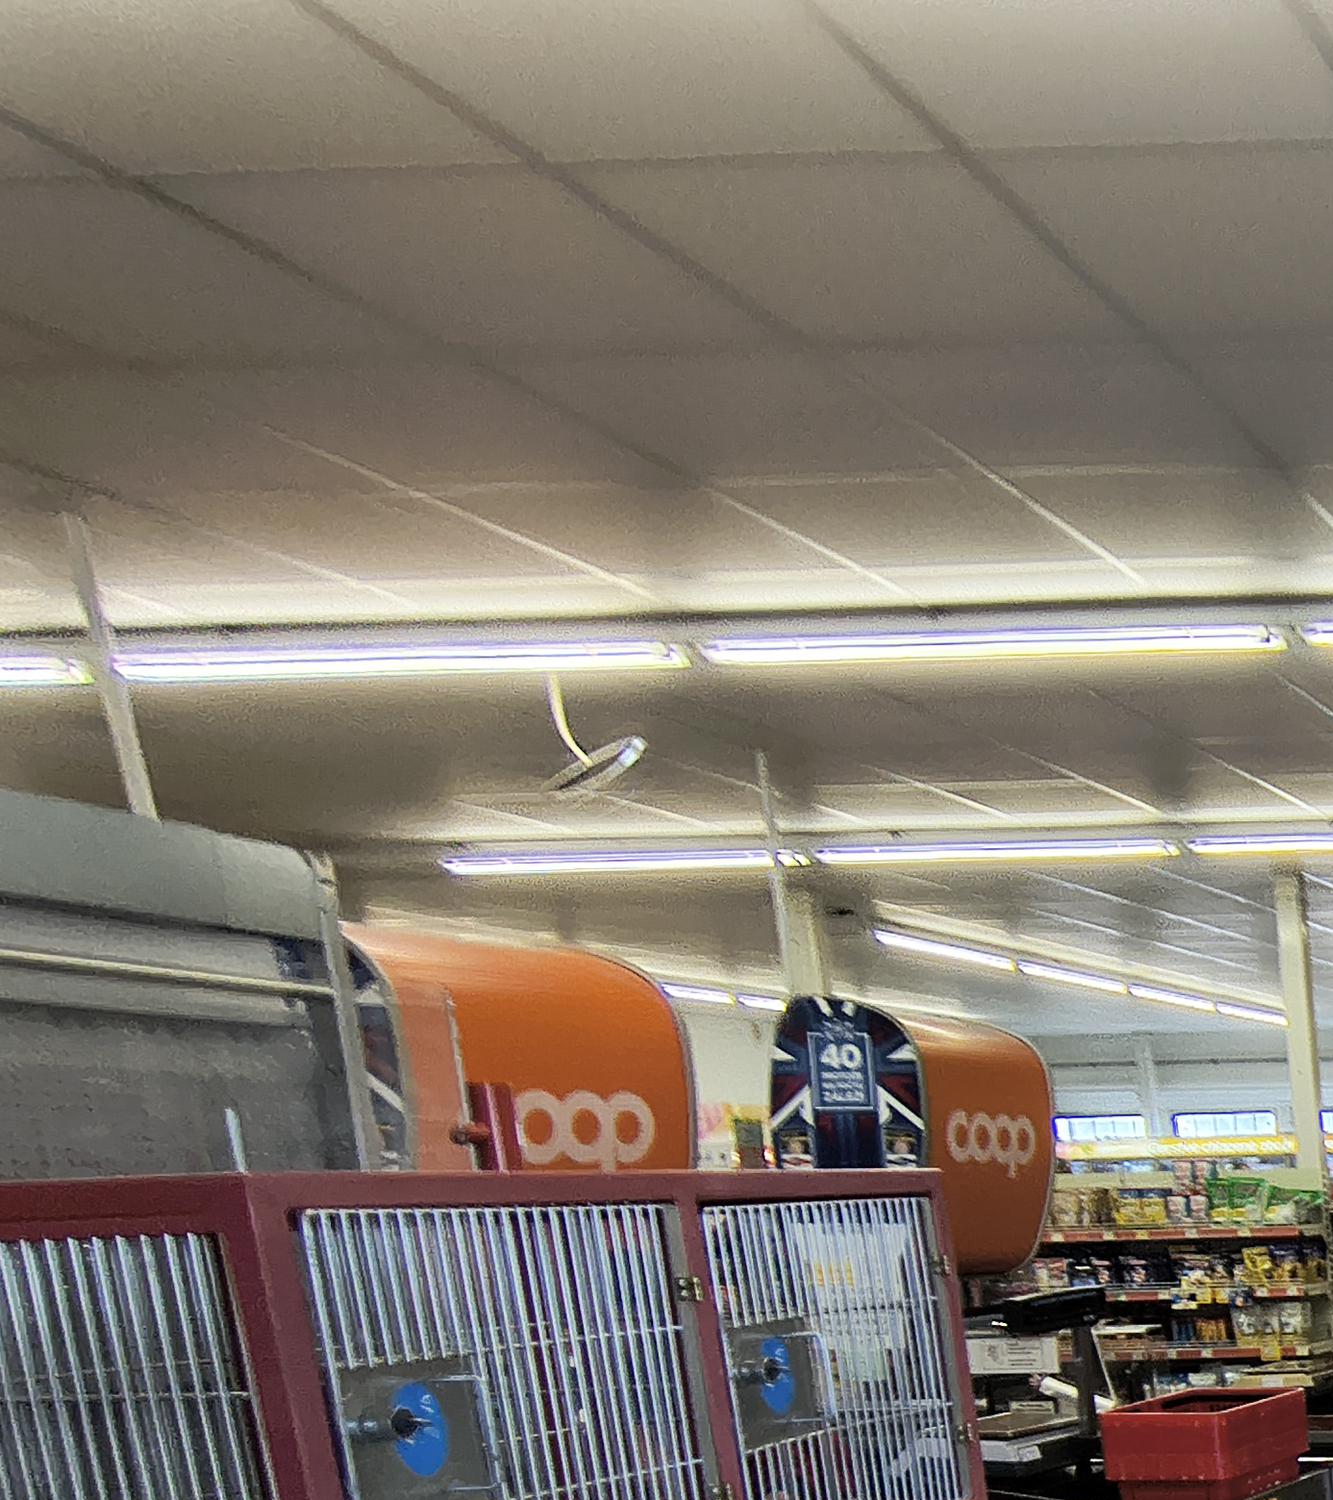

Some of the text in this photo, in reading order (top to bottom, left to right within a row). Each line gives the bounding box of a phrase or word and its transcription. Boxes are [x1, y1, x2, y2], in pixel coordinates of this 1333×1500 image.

[820, 1043, 864, 1070] 40
[516, 1088, 656, 1175] oop
[946, 1108, 1036, 1179] coop
